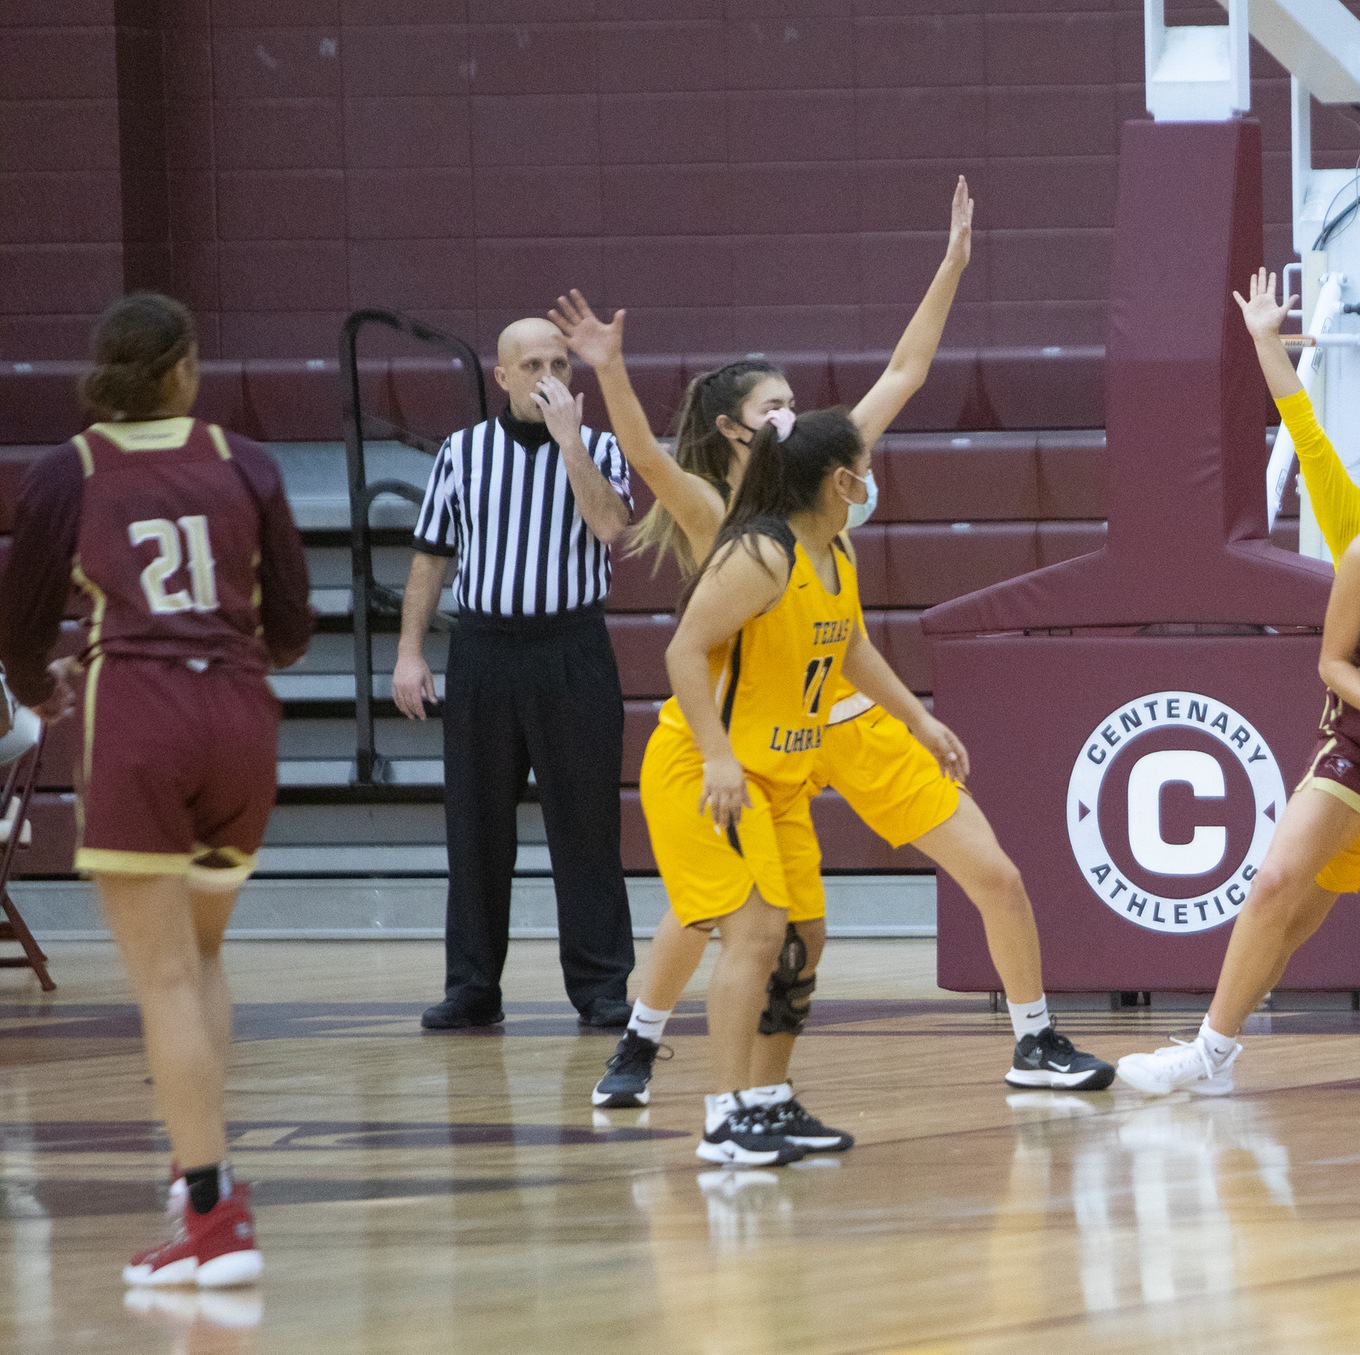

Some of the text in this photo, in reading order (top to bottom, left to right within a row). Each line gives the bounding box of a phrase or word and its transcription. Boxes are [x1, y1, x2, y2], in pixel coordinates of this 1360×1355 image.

[127, 514, 220, 614] 21
[1086, 698, 1268, 765] CENTENARY
[1127, 750, 1227, 875] C
[1090, 863, 1258, 925] ATHLETICS
